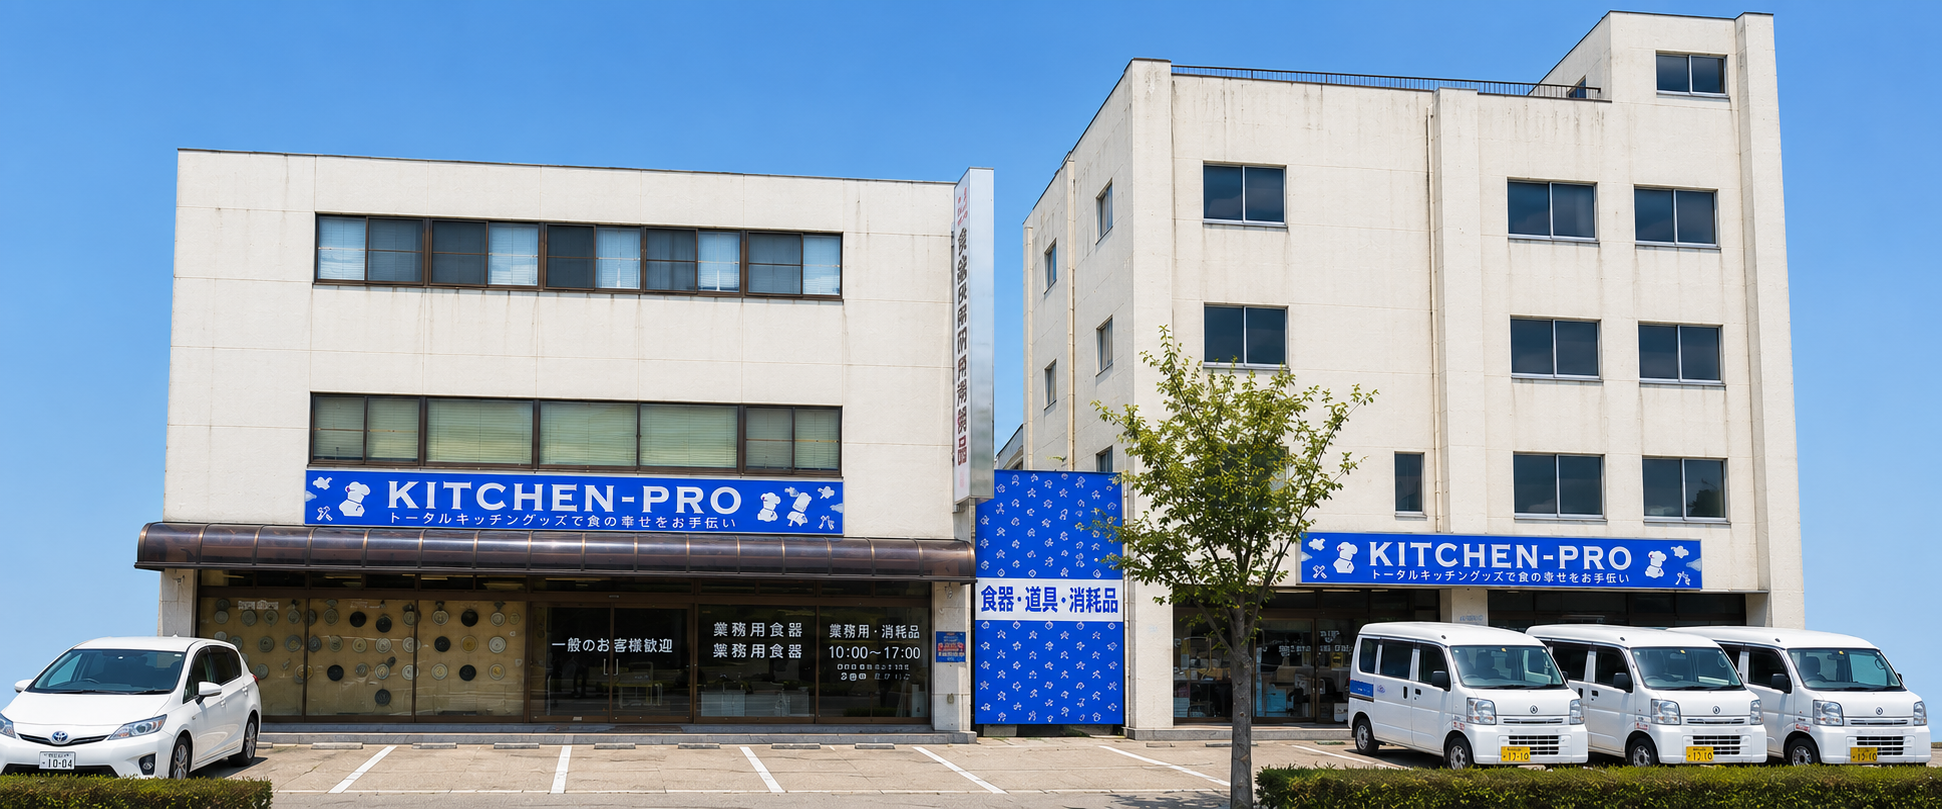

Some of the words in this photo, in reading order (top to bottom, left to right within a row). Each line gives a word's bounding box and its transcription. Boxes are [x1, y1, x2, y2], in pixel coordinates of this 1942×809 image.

[387, 480, 742, 515] KITCHEN-PRO
[1369, 541, 1632, 571] KITCHEN-PRO
[980, 585, 1119, 613] 食器・道具・消耗品
[713, 621, 803, 638] 業務用食器
[551, 637, 673, 653] 一般のお客様歓迎
